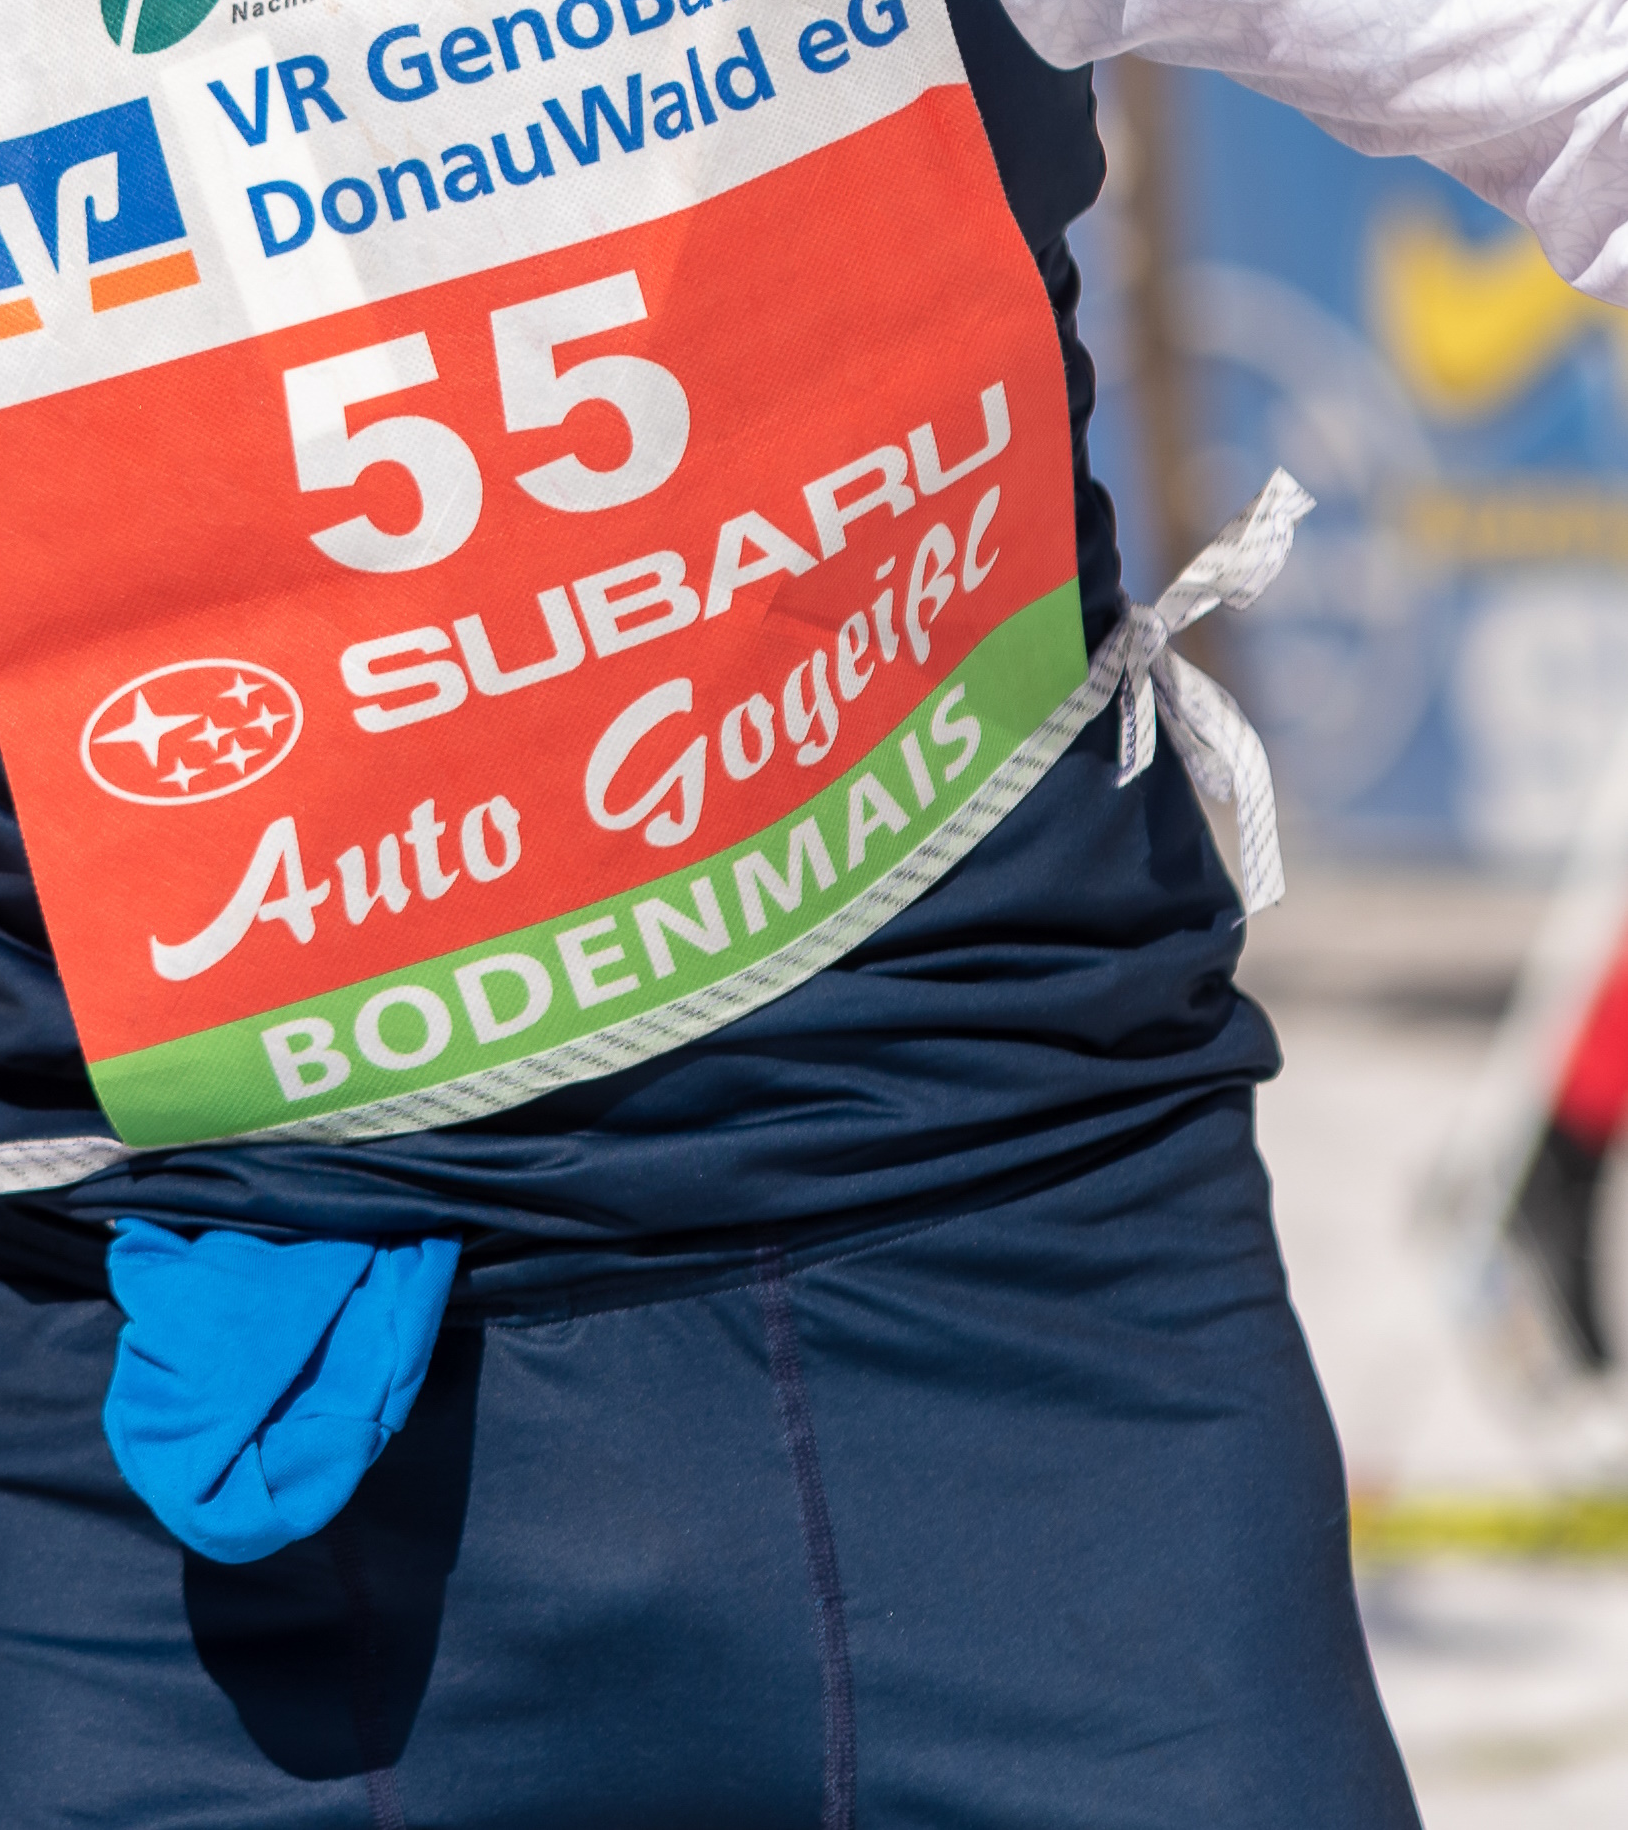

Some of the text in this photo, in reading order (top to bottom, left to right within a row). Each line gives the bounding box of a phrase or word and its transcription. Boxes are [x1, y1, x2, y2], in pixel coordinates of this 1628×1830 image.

[206, 54, 347, 148] VR
[245, 27, 777, 260] DonauWald
[283, 269, 691, 575] 55
[339, 381, 1014, 734] SUBARU
[149, 794, 521, 982] Auto
[260, 679, 982, 1103] BODENMAIS
